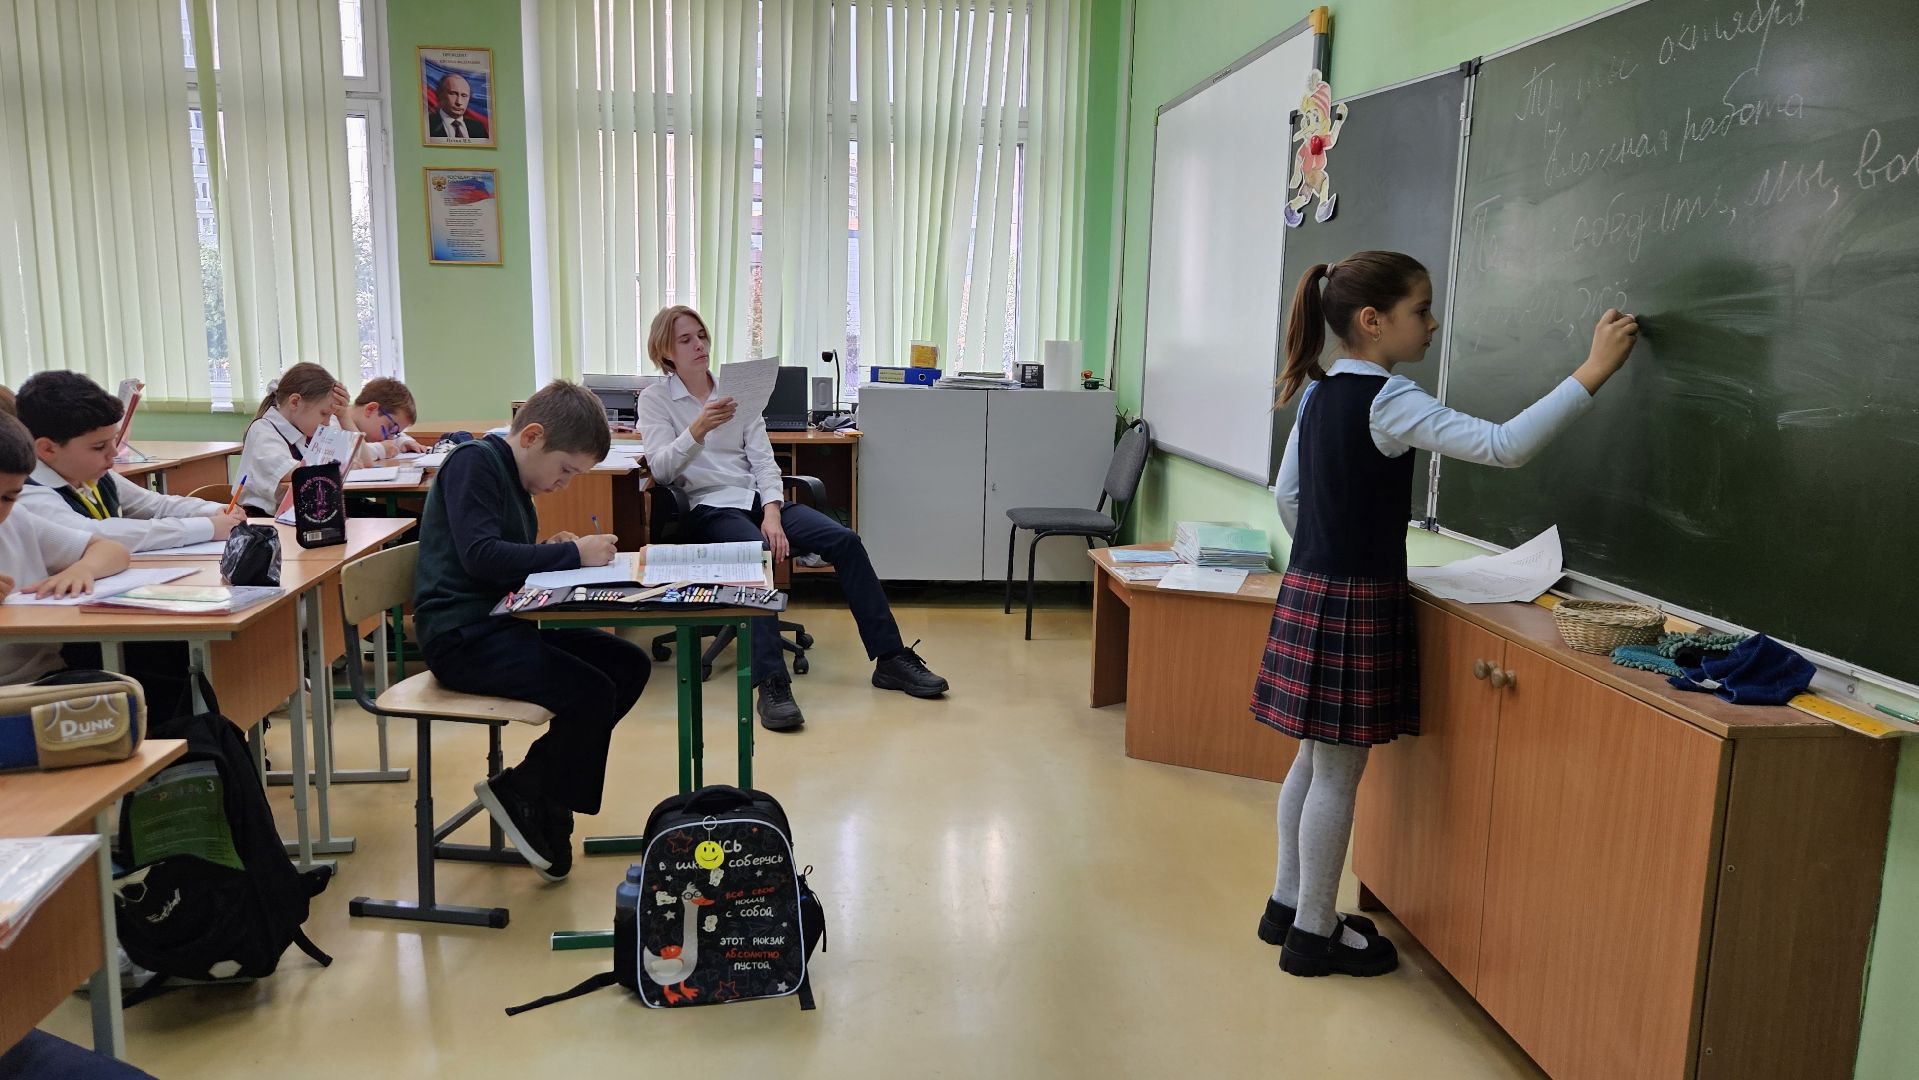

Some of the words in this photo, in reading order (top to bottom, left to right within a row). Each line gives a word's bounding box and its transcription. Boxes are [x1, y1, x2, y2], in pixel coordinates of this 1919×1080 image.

[1679, 66, 1805, 164] работа
[1743, 159, 1841, 220] мы,
[1852, 127, 1919, 190] во
[206, 778, 215, 792] 3
[720, 937, 745, 946] ЭТОТ
[752, 936, 786, 946] РЮКЗАК
